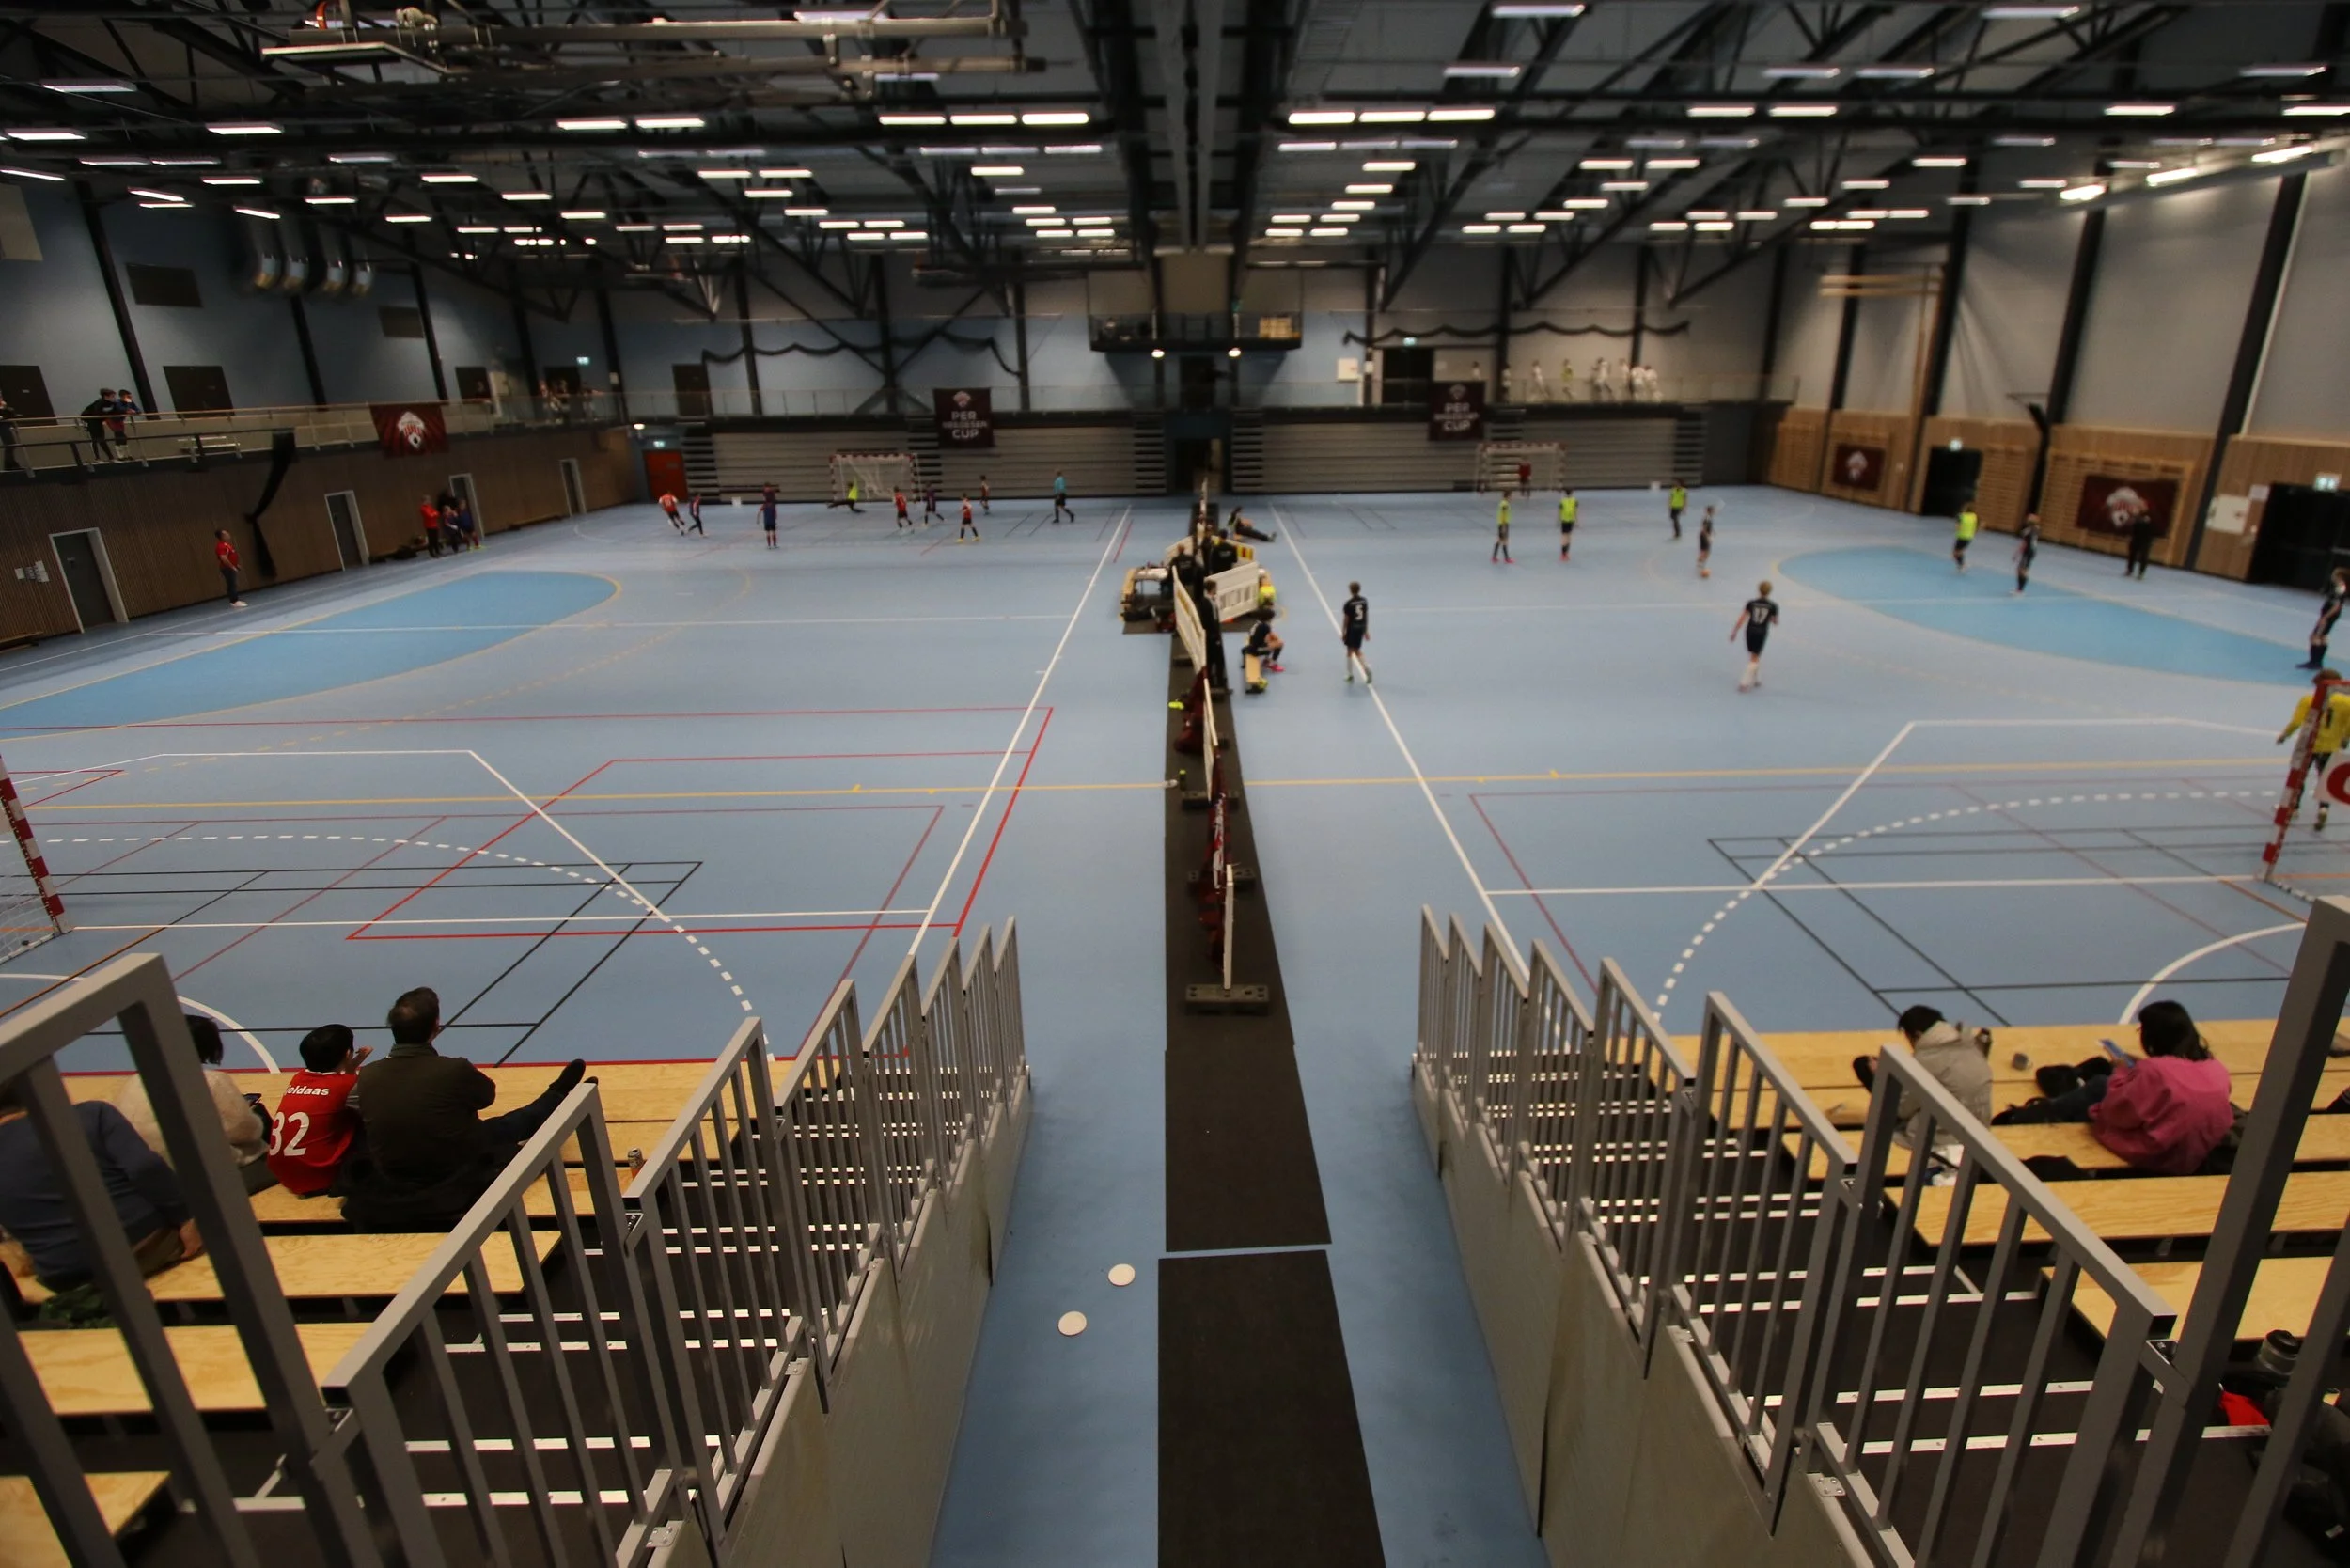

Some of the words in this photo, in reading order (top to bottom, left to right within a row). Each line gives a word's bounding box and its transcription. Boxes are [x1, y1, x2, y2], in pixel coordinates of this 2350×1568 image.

[951, 410, 977, 420] PER
[952, 429, 979, 439] CUP
[1355, 604, 1364, 620] 5
[1752, 607, 1769, 624] 17
[269, 1111, 310, 1156] 32
